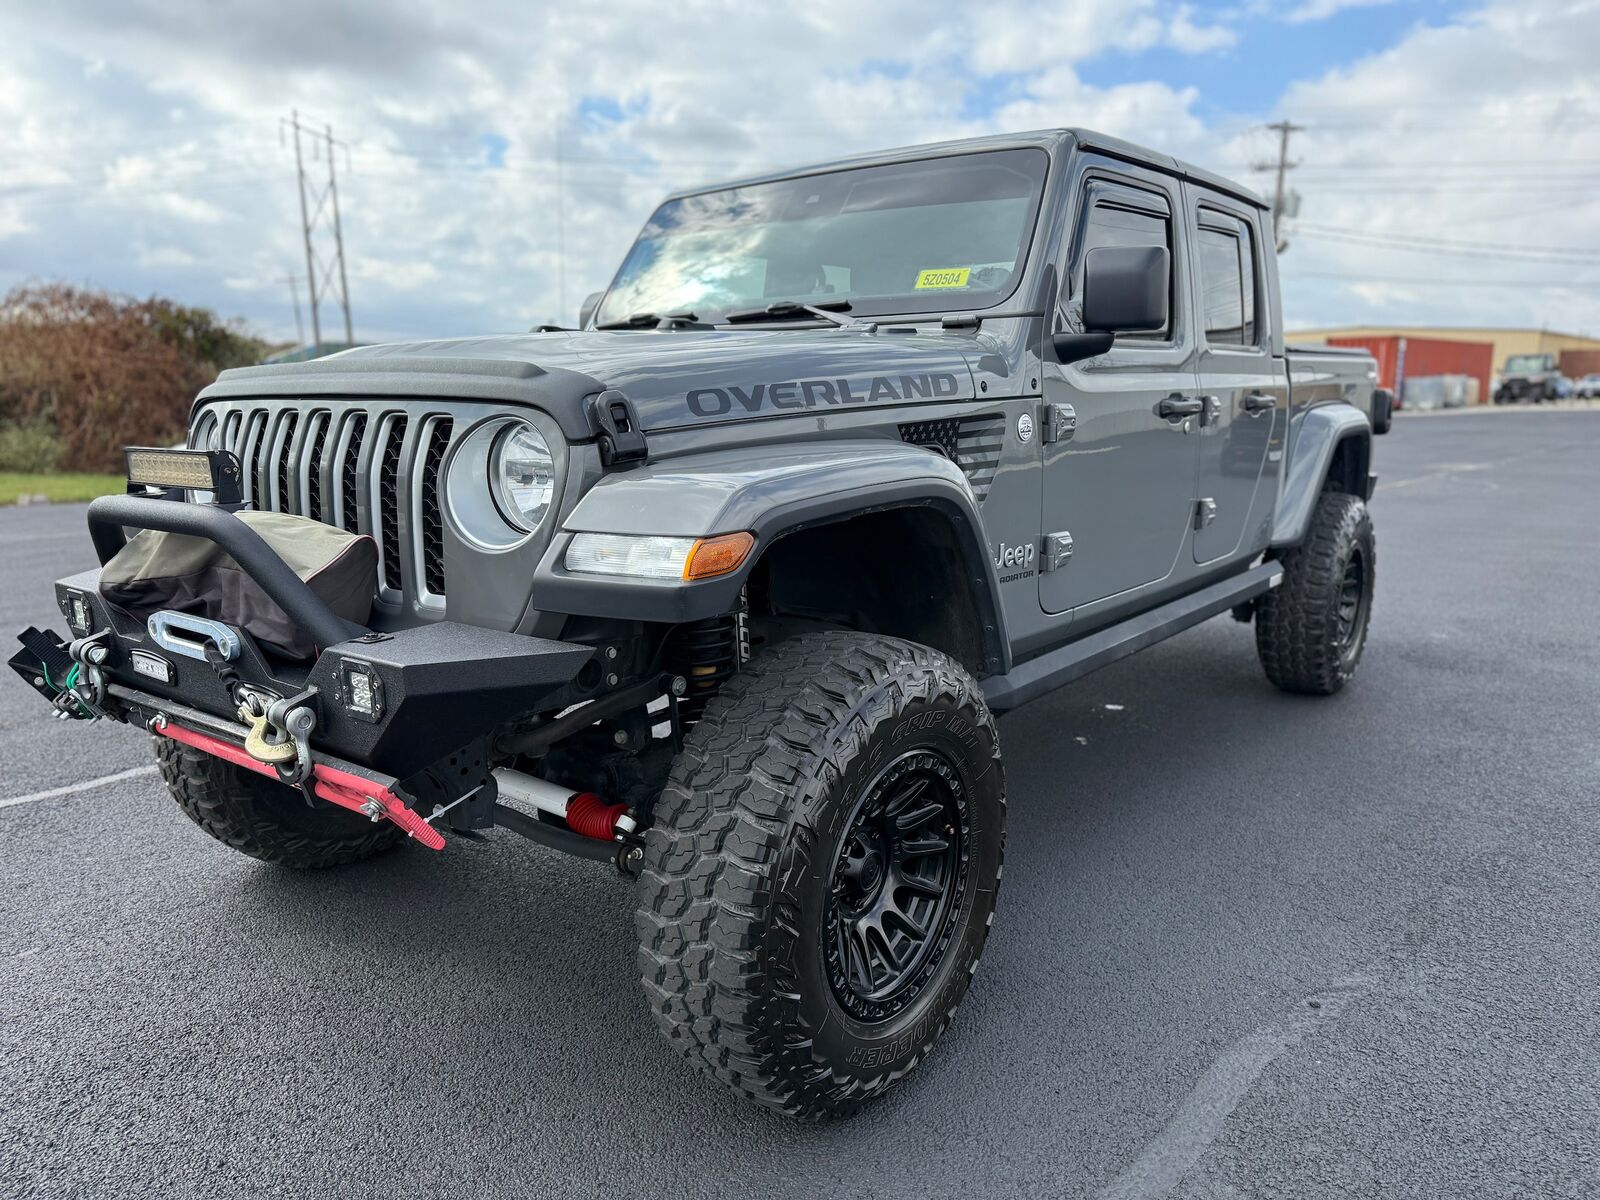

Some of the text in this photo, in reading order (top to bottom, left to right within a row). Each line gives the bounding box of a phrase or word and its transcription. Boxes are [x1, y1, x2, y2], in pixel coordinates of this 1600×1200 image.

[922, 272, 961, 286] 5Z0504
[687, 373, 959, 417] OVERLAND
[994, 543, 1035, 570] Jeep
[999, 570, 1034, 584] ADIATOR
[740, 583, 751, 663] FALCO
[891, 710, 946, 745] GRIP
